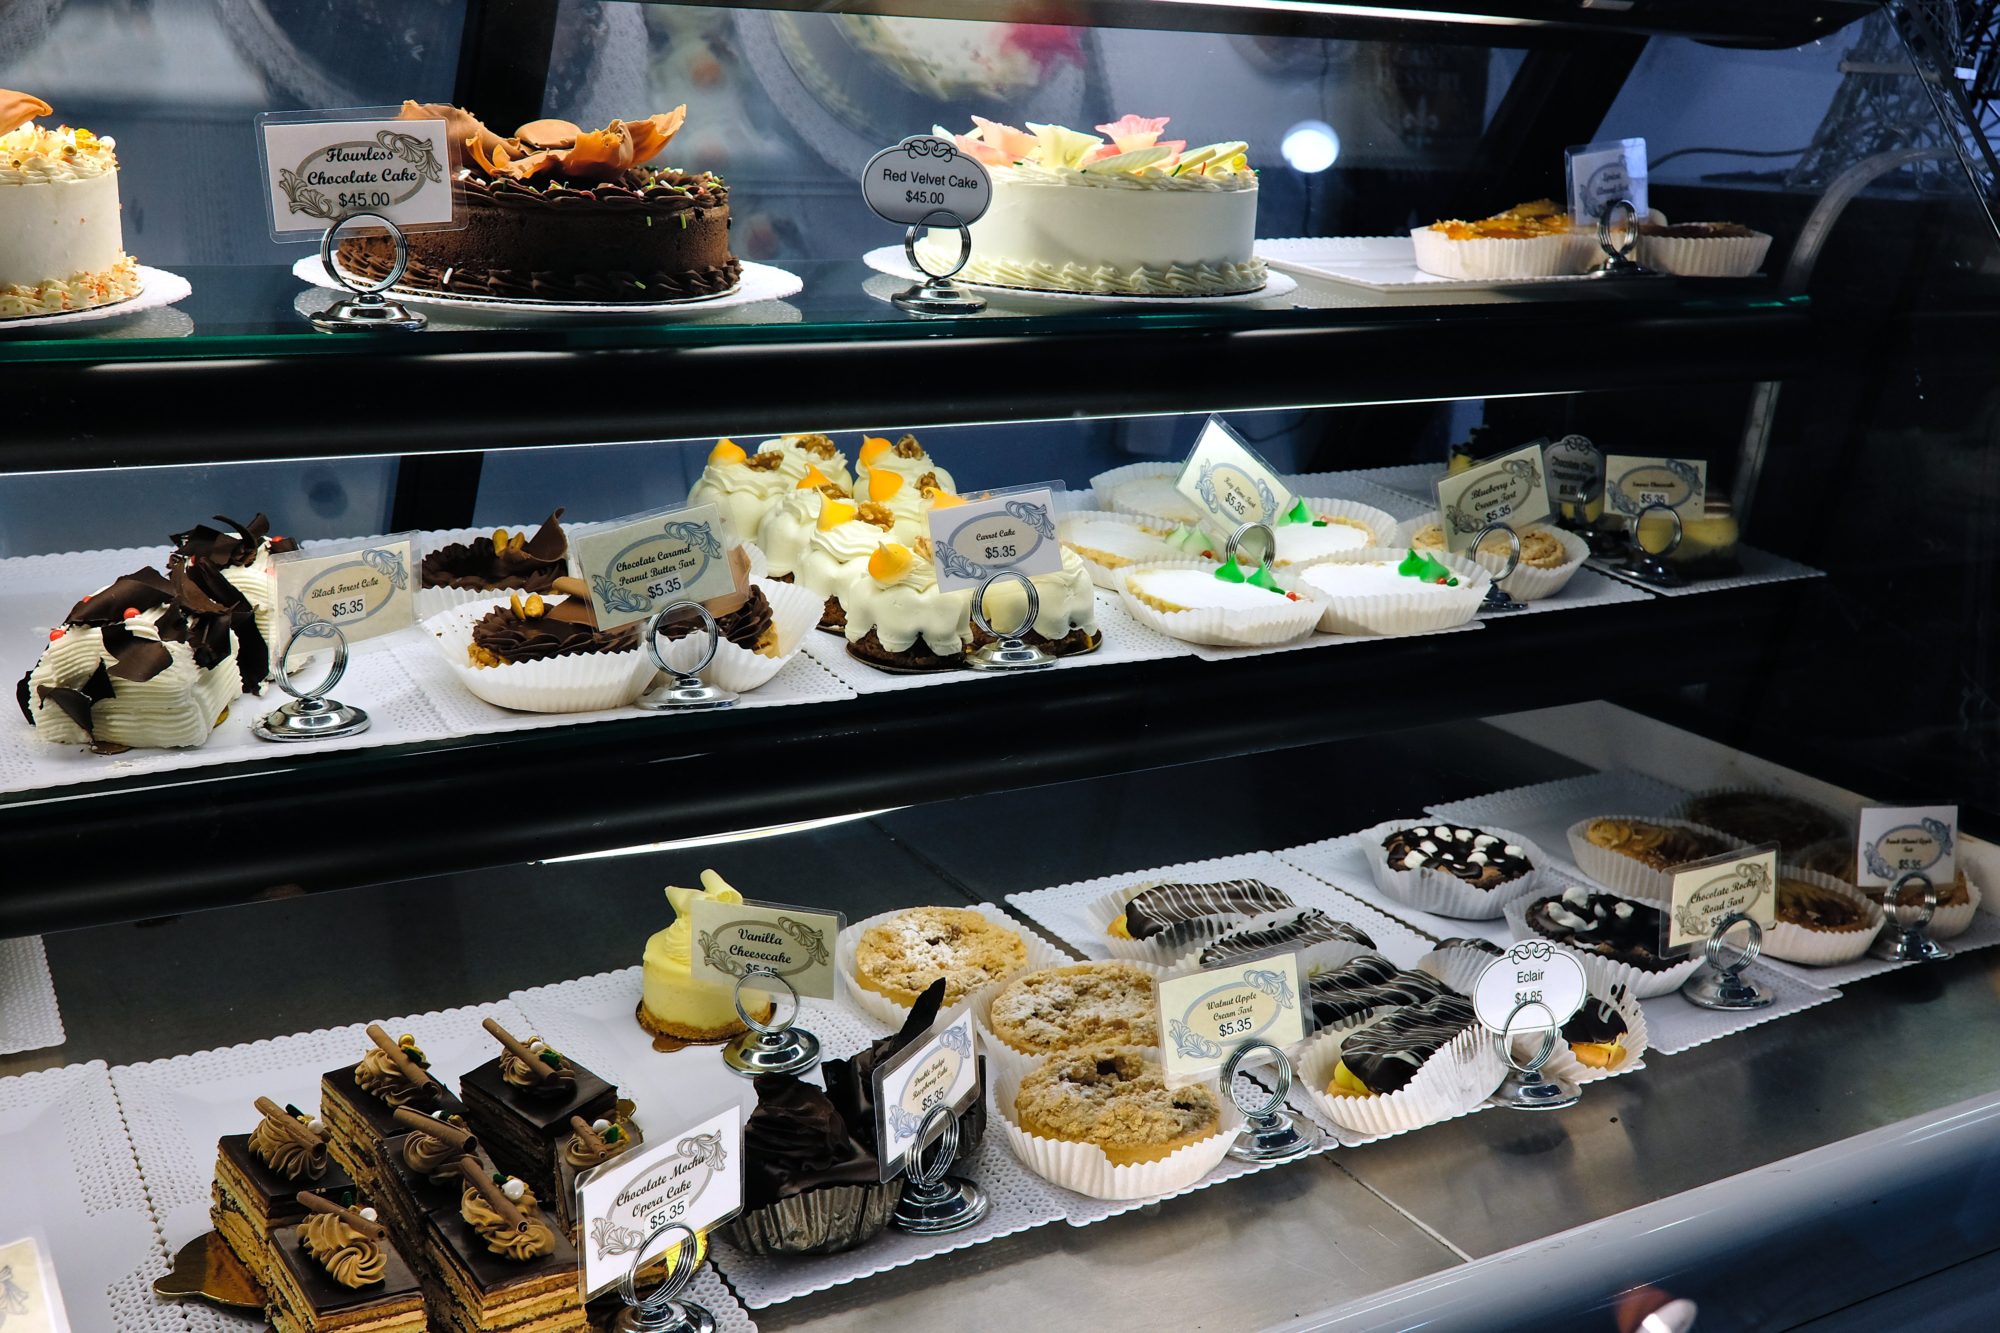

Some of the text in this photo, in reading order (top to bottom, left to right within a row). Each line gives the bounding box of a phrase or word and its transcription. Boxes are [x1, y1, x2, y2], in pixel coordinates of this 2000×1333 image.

[326, 147, 394, 163] Flourless
[307, 167, 417, 186] Chocolate Cake
[883, 168, 978, 189] Red Velvet Cake
[338, 192, 390, 208] $45.00
[905, 190, 945, 204] $45.00
[1471, 482, 1508, 500] Blueberry
[1475, 491, 1517, 511] Cream Tart
[1225, 492, 1245, 515] $5.35
[1486, 504, 1511, 523] $5.35
[976, 528, 1016, 541] Carrot Cake
[616, 543, 692, 572] Chocolate Caramel
[985, 545, 1016, 559] $5.35
[619, 557, 696, 587] Peanut Butter Tart
[311, 577, 379, 599] Black Forest Cake
[647, 577, 682, 600] $5.35
[332, 598, 364, 618] $5.35
[1690, 878, 1758, 905] Chocolate Rocky
[1701, 896, 1745, 916] Road Tart
[738, 928, 783, 946] Vanilla
[729, 944, 792, 964] Cheesecake
[1517, 969, 1544, 983] Eclair
[1206, 992, 1257, 1011] Walnut Apple
[1213, 1005, 1253, 1022] Cream Tart
[1219, 1017, 1252, 1037] $5.35
[922, 1087, 944, 1112] $5.35
[616, 1155, 705, 1207] Chocolate Mocha
[632, 1179, 692, 1217] Opera Cake
[650, 1200, 685, 1230] $5.35
